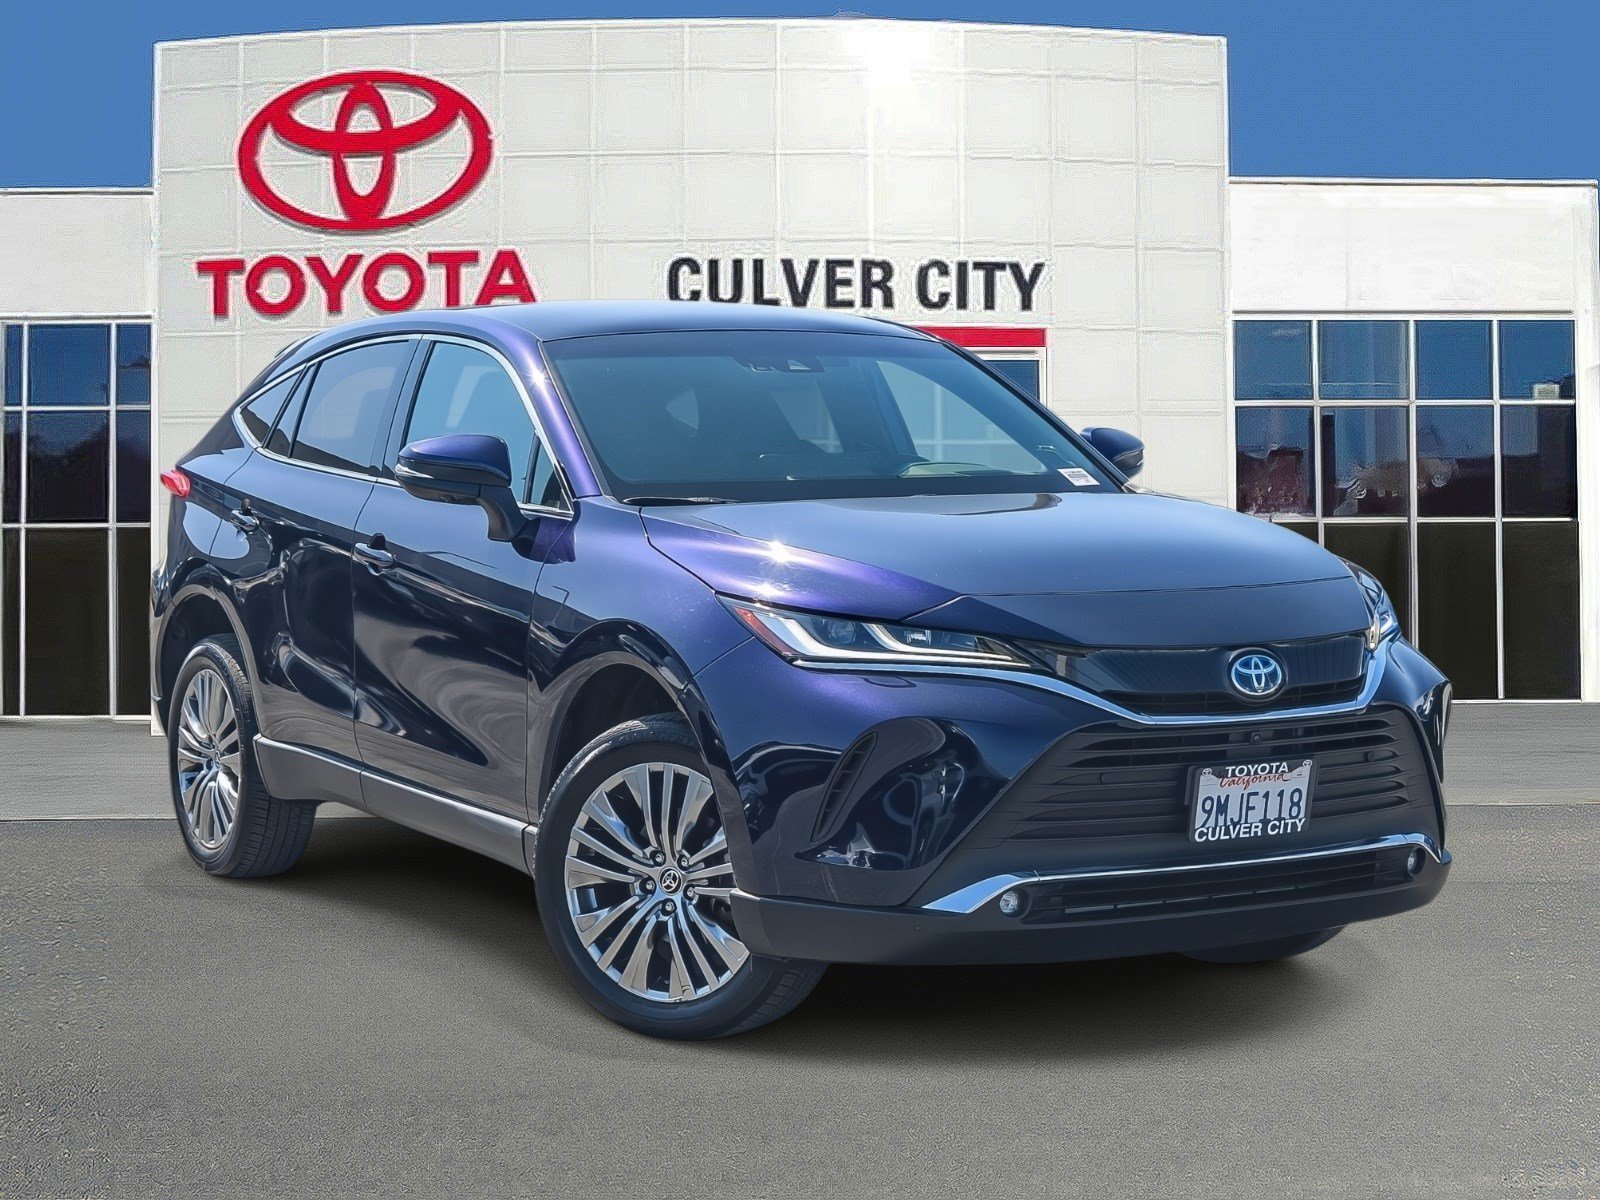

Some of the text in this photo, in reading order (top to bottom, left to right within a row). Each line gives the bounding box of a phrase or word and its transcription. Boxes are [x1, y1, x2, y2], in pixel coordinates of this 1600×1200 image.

[197, 249, 537, 317] TOYOTA
[667, 257, 1046, 312] CULVER CITY
[1225, 761, 1289, 778] TOYOTA
[1200, 787, 1303, 828] 9MJF118
[1194, 818, 1305, 842] CULVER CITY
